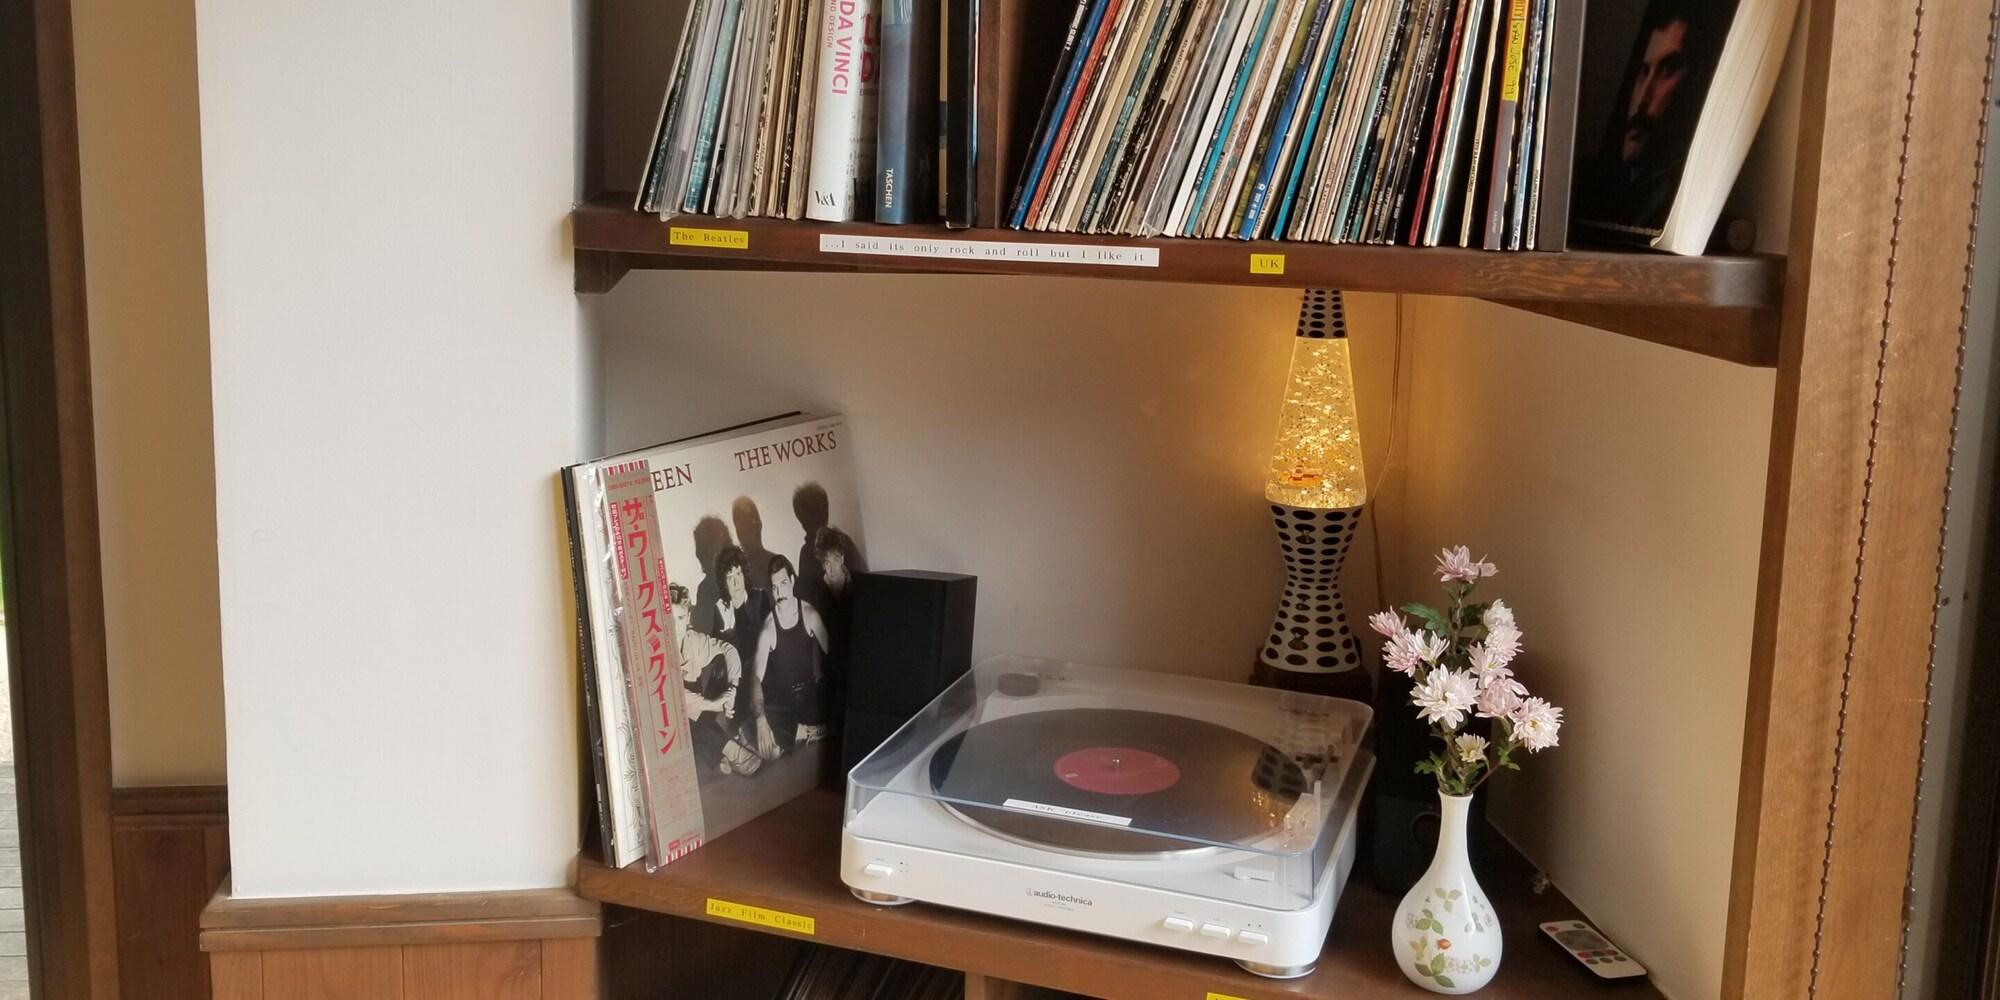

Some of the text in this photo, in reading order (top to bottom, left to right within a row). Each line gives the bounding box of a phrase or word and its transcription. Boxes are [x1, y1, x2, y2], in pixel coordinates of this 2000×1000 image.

[827, 15, 836, 48] DESIGN
[832, 1, 855, 94] DA VINCI
[815, 190, 836, 206] V&A
[885, 168, 894, 208] TASCHEN
[674, 232, 745, 243] The Beatles
[855, 241, 879, 250] said
[889, 242, 904, 251] its
[914, 244, 939, 254] only
[950, 245, 975, 255] rock
[985, 247, 1006, 256] and
[1017, 248, 1040, 257] roll
[1050, 248, 1071, 258] but
[1081, 249, 1086, 259] I
[1098, 250, 1122, 260] like
[1134, 252, 1144, 261] it
[1260, 258, 1279, 268] UK
[651, 463, 693, 492] EEN
[734, 445, 772, 472] THE
[772, 431, 837, 463] WORKS
[1033, 889, 1093, 906] audio-technica
[709, 903, 813, 929] Jazz Film Classic
